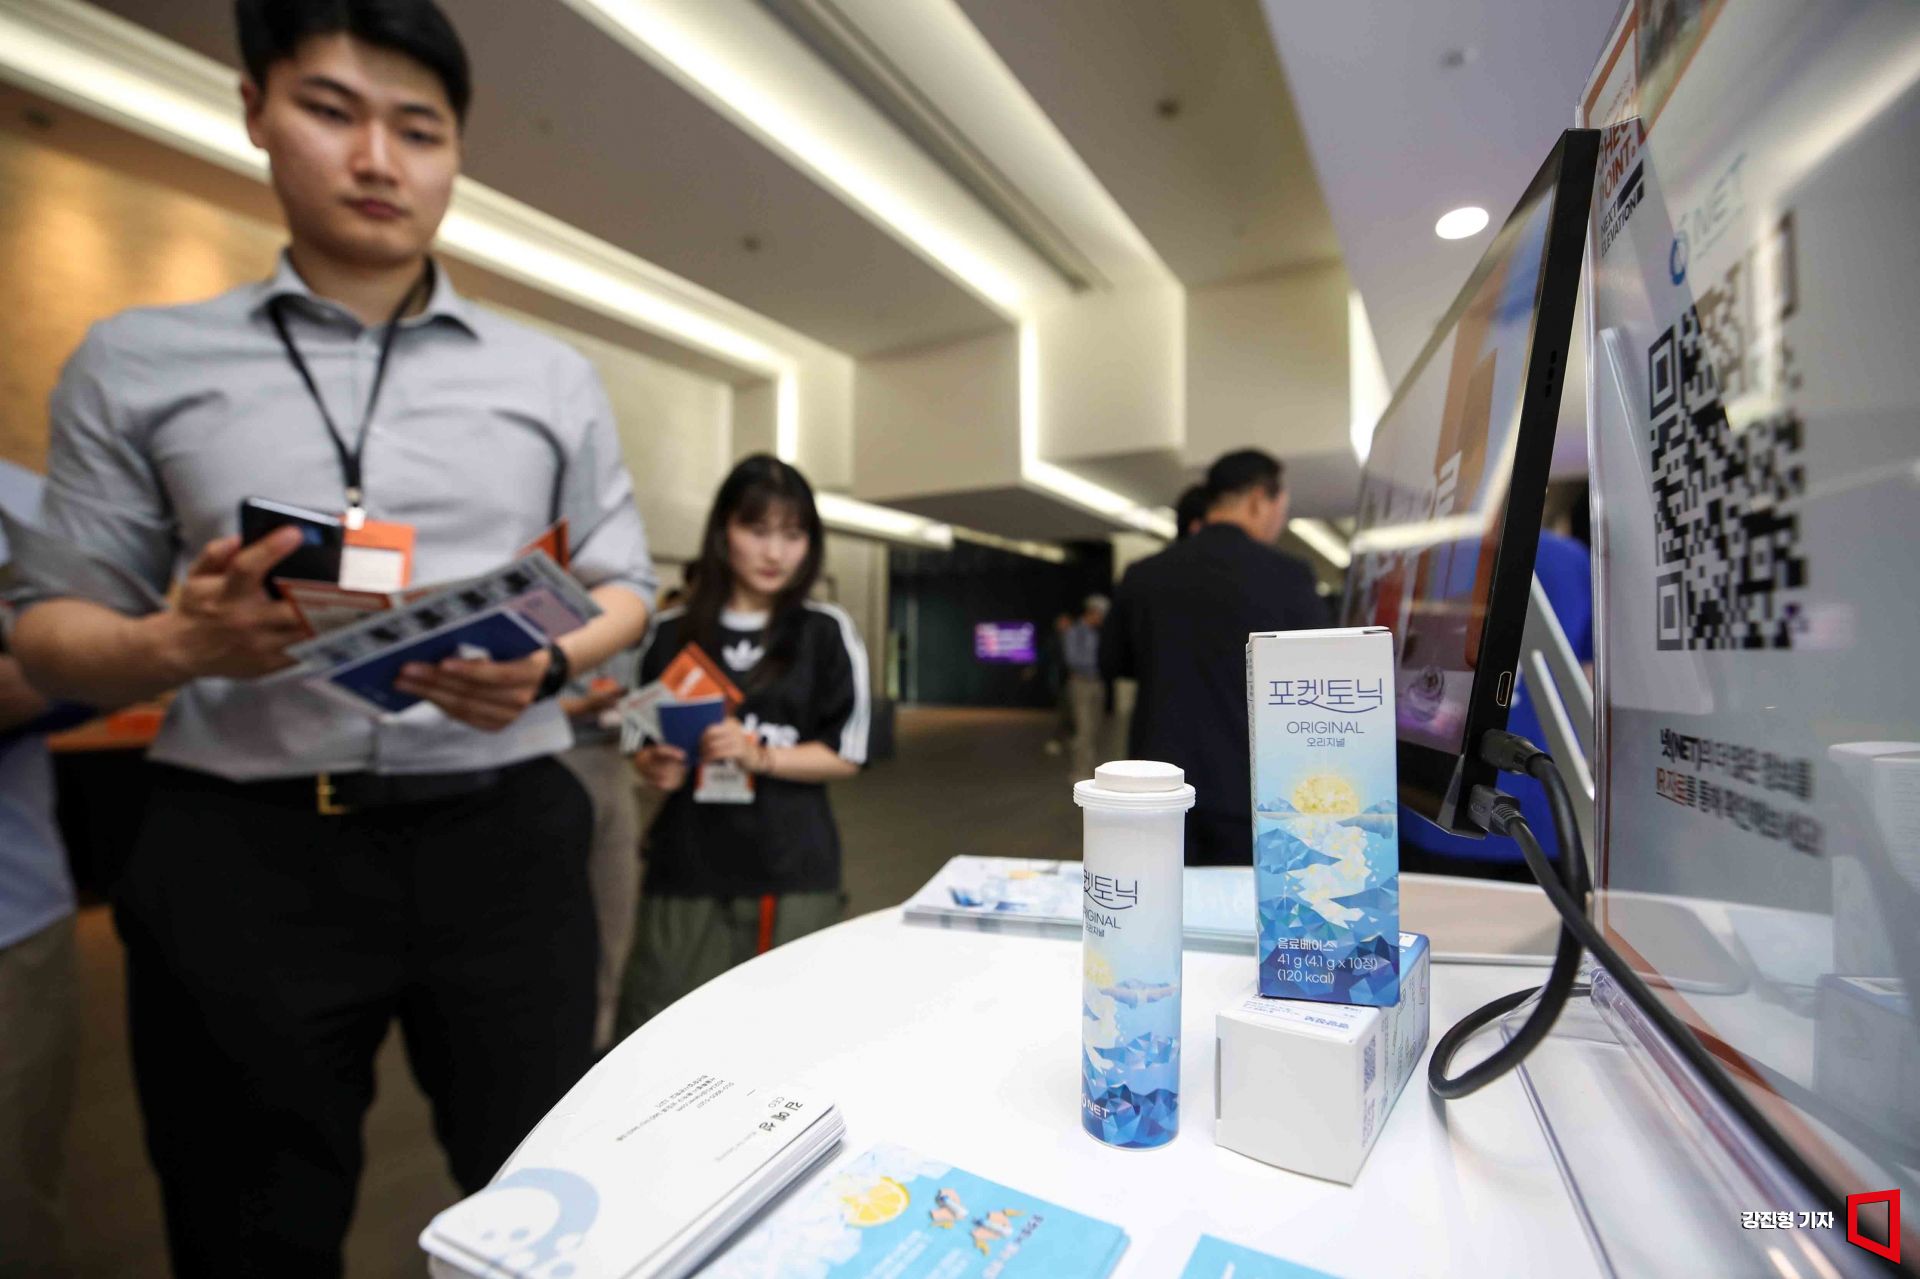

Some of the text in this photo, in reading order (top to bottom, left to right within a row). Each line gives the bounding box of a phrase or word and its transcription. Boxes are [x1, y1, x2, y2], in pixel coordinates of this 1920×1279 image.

[1601, 200, 1617, 240] NEXT
[1601, 192, 1637, 257] ELEVATION
[1268, 678, 1383, 714] 포켓토닉
[1286, 721, 1365, 734] ORIGINAL
[1306, 737, 1345, 748] 오리지널
[1277, 937, 1338, 951] 음료베이스
[1277, 954, 1290, 966] 41
[1293, 957, 1302, 969] g
[1304, 954, 1323, 969] (4.1
[1327, 958, 1335, 970] g
[1277, 970, 1335, 985] (120 kcal)
